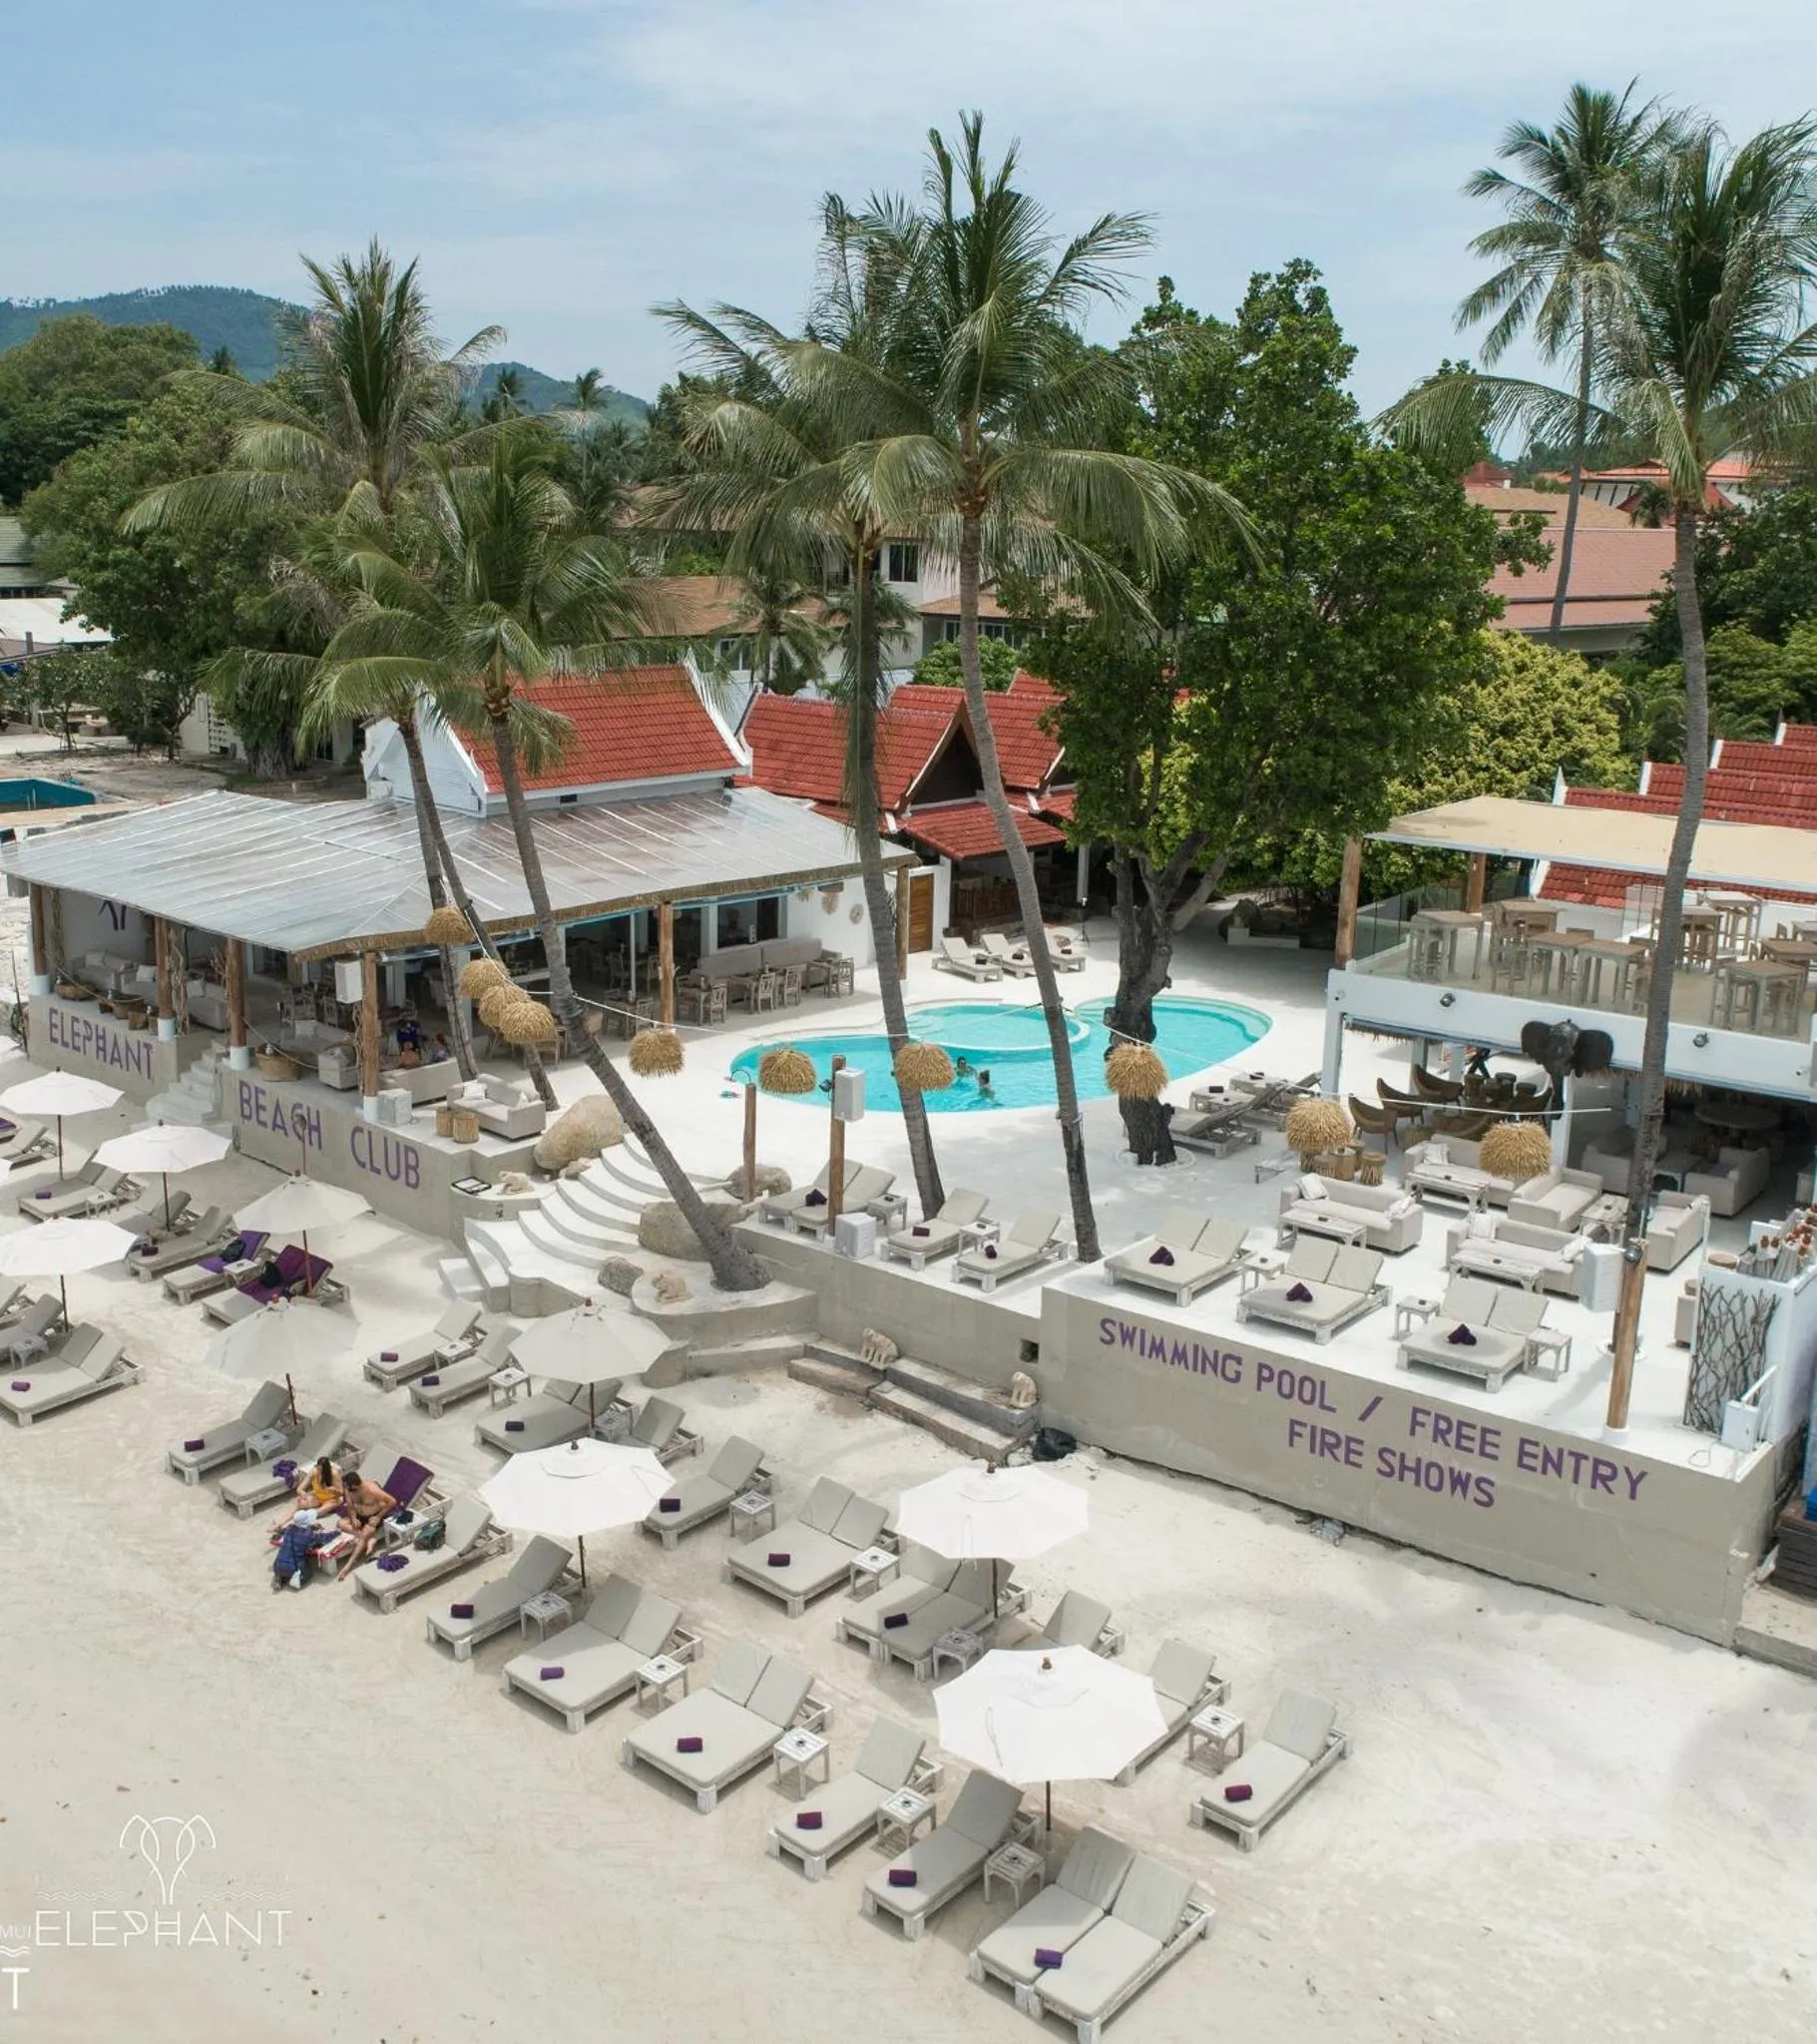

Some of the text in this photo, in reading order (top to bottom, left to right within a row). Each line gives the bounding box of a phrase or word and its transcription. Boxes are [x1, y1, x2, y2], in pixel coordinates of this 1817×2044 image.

[49, 1007, 154, 1080] ELEPHANT
[238, 1080, 420, 1190] BEACH CLUB
[1100, 1317, 1242, 1384] SWIMMING
[1256, 1361, 1337, 1413] POOL
[1409, 1405, 1501, 1461] FREE
[1516, 1437, 1648, 1501] ENTRY
[1287, 1417, 1496, 1508] FIRE SHOWS
